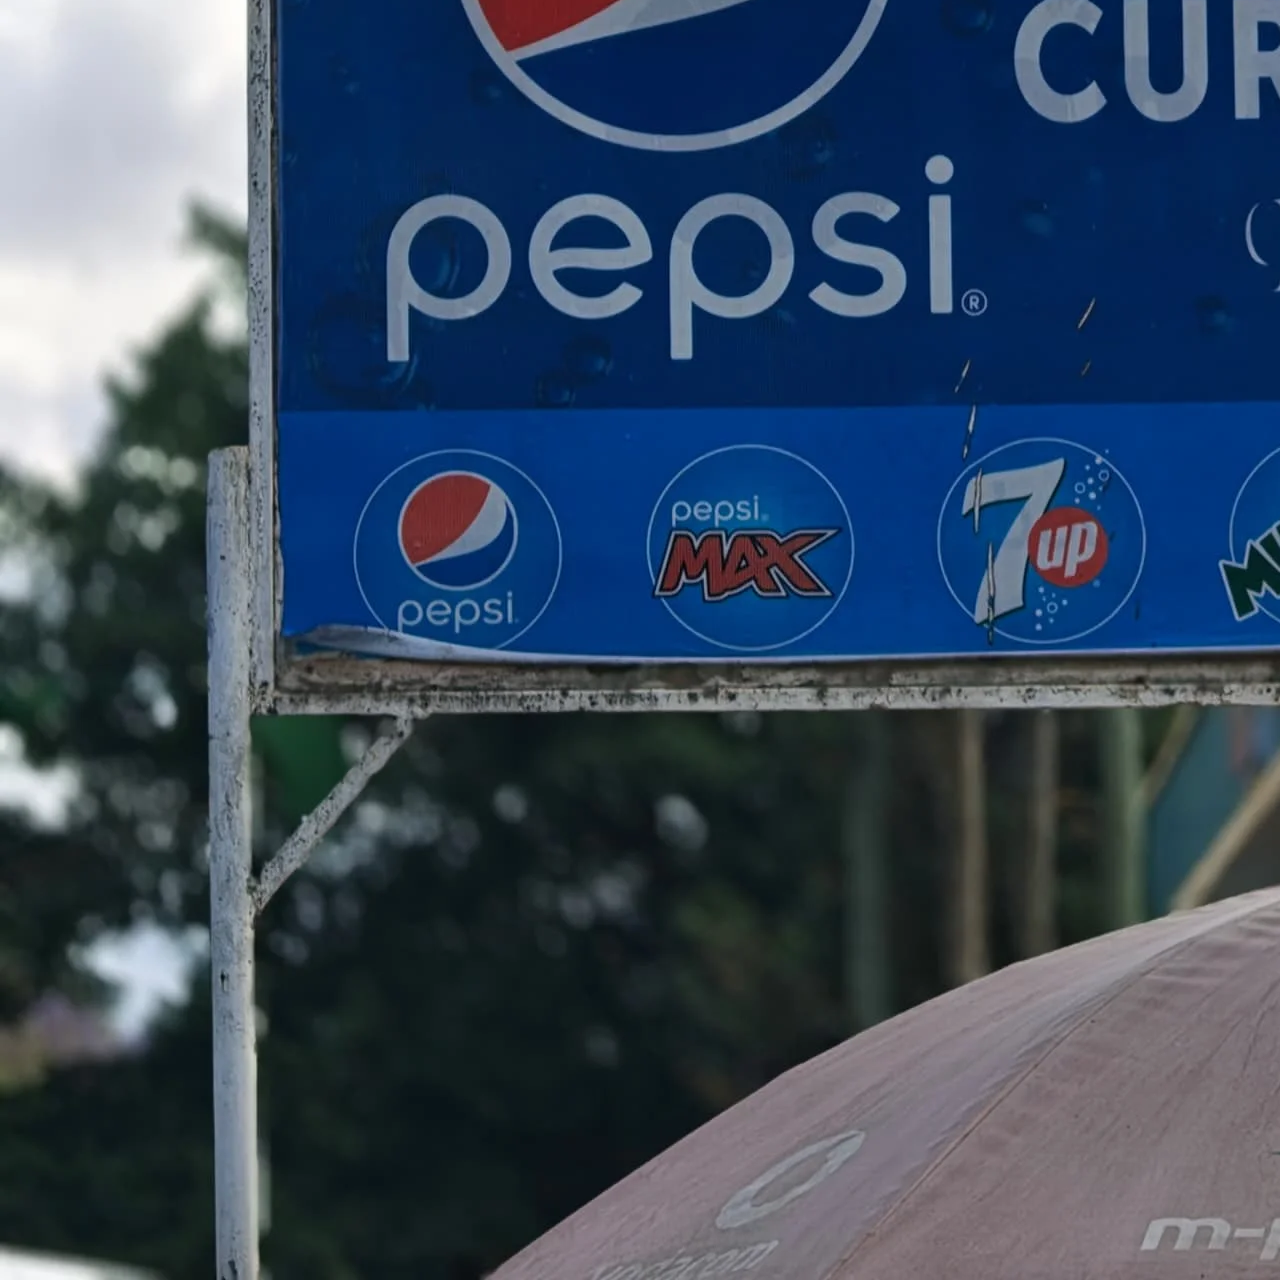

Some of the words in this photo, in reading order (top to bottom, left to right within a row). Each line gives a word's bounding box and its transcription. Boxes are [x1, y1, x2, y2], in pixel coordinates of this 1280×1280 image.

[671, 495, 761, 526] pepsi
[655, 529, 841, 602] MAX
[398, 591, 515, 633] pepsi
